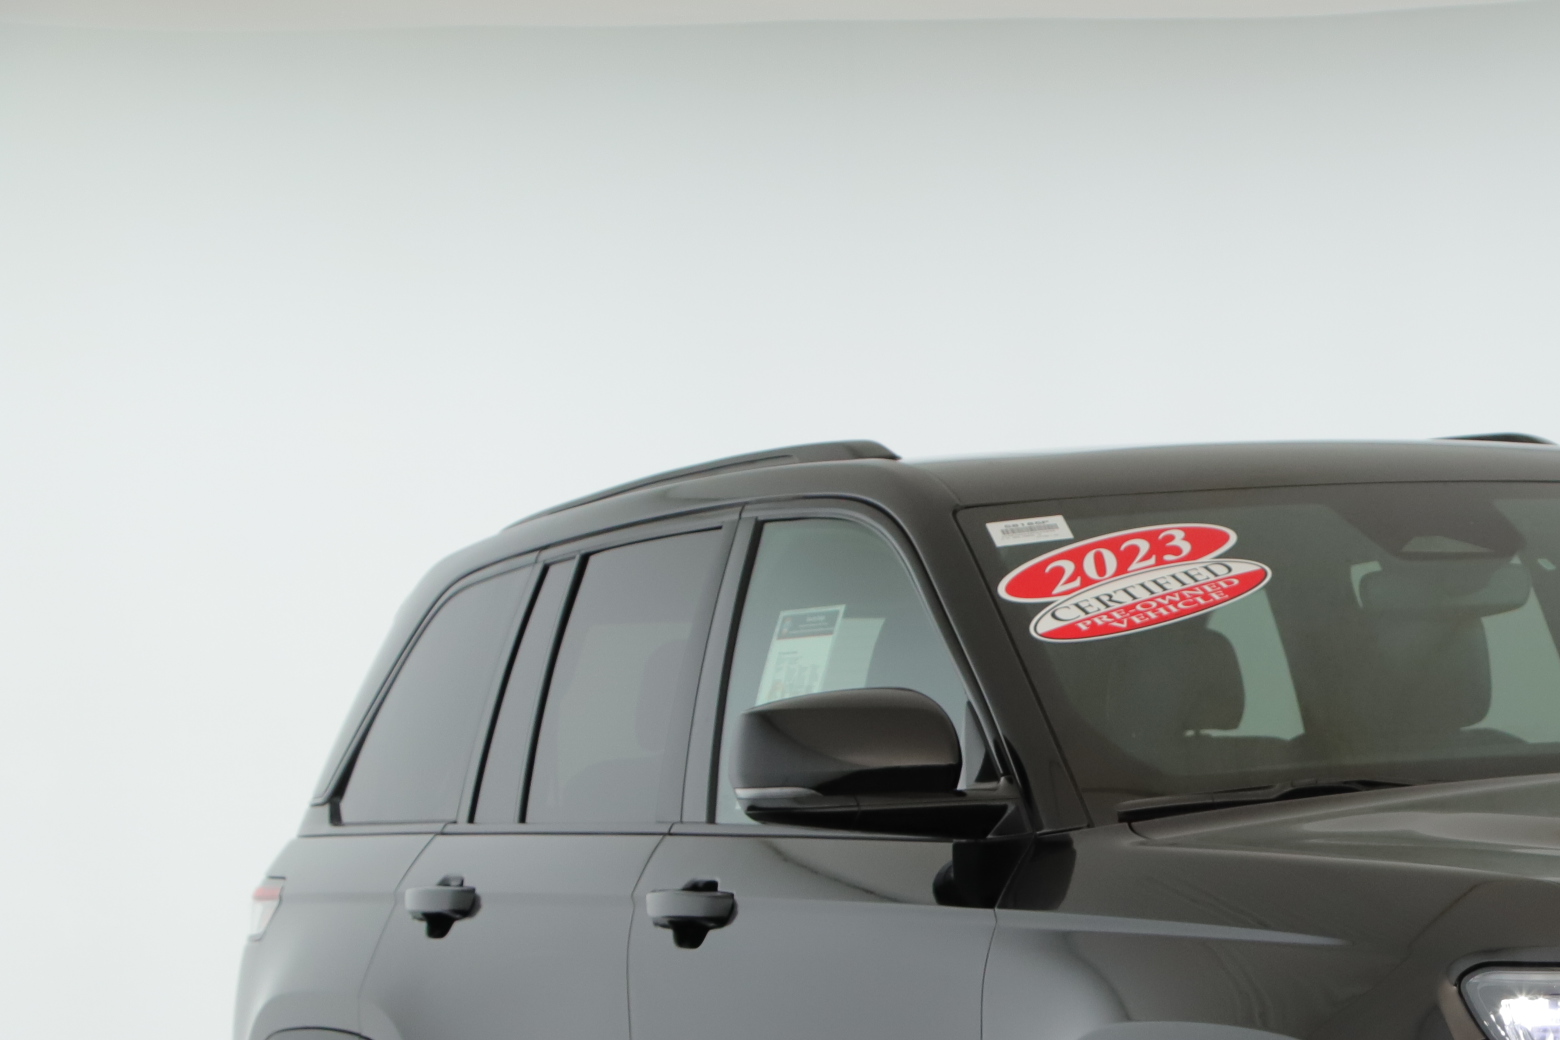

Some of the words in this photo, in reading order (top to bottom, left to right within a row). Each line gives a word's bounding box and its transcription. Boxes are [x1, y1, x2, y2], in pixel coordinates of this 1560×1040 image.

[1045, 529, 1192, 595] 2023
[1050, 562, 1233, 622] CERTIFIED
[1076, 578, 1240, 631] PRE-OWNED
[1109, 589, 1229, 628] VEHICLE
